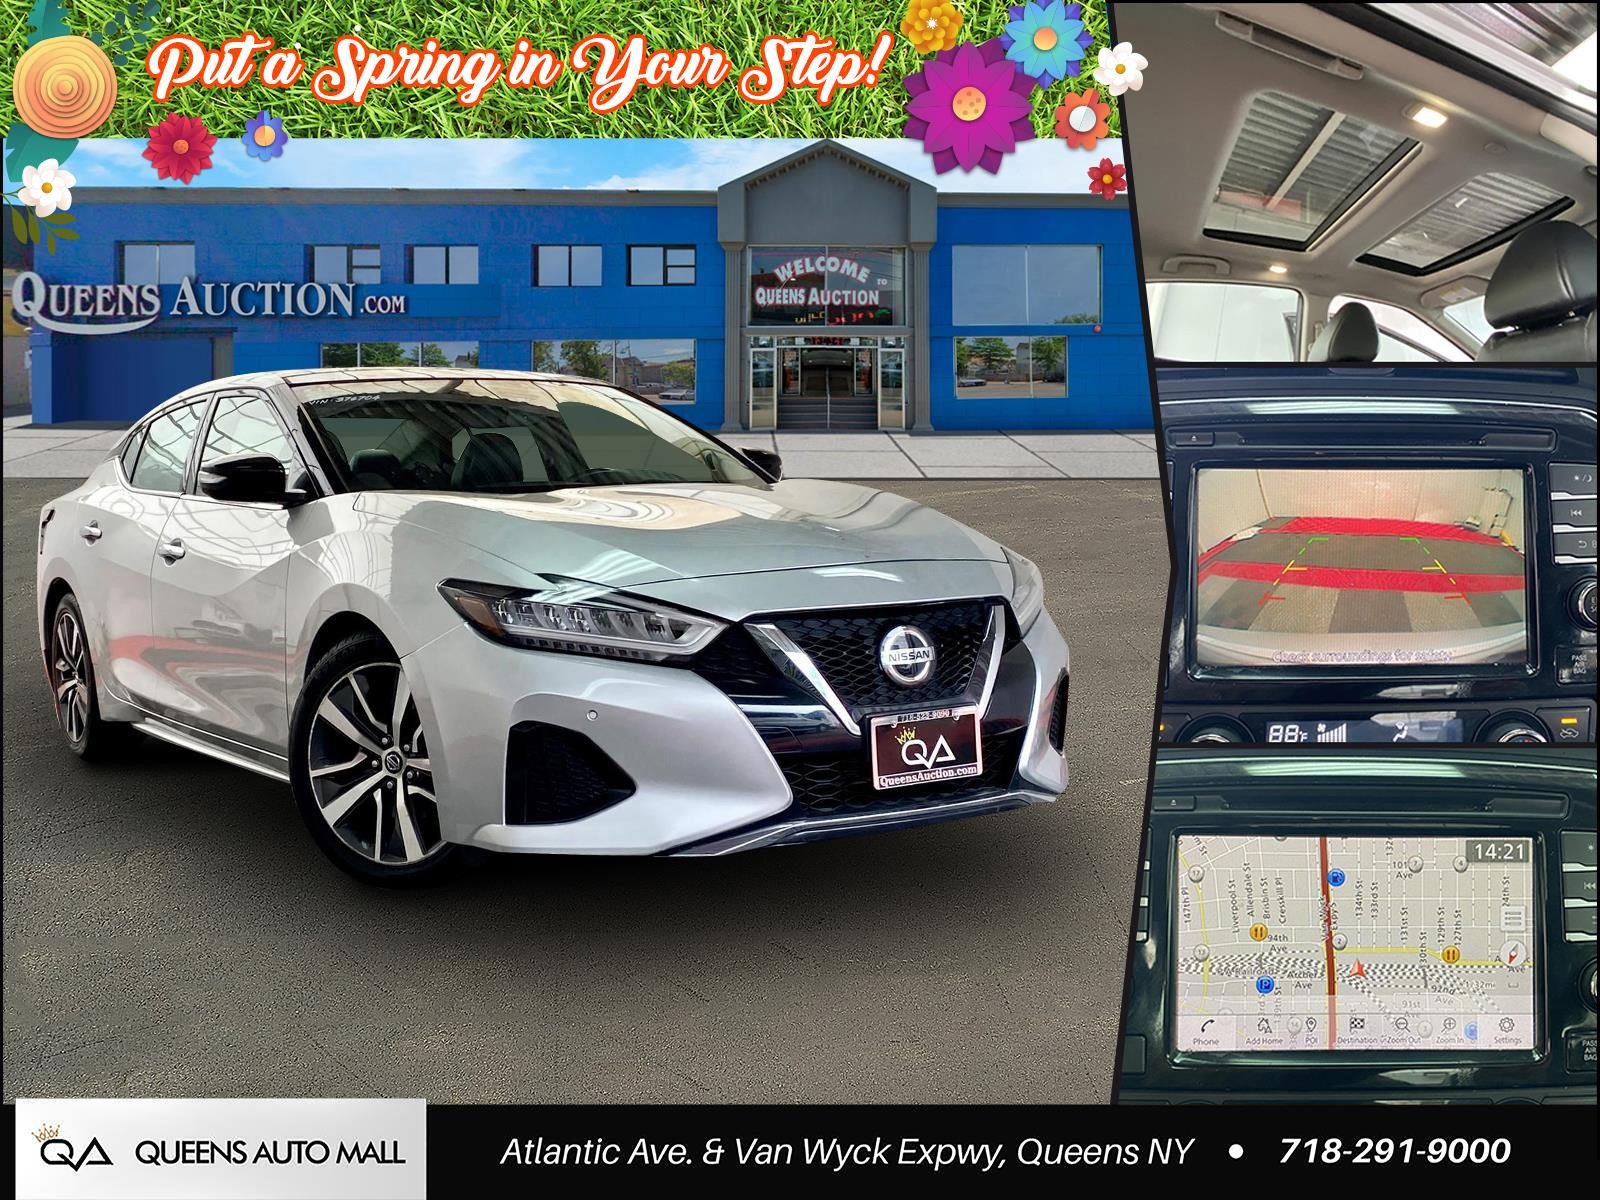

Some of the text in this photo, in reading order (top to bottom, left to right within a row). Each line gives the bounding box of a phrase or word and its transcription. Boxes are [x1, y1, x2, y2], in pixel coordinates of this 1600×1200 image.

[774, 256, 888, 286] WELCOME TO
[755, 287, 879, 306] QUEENS AUCTION
[12, 271, 160, 335] QUEENS
[888, 650, 930, 662] NISSAN
[1272, 650, 1307, 662] Check
[1312, 650, 1392, 663] surroundings
[1393, 650, 1412, 661] for
[902, 735, 956, 769] QA
[879, 765, 977, 788] QueensAuction.com
[1474, 843, 1525, 860] 14:21
[1396, 871, 1413, 879] Ave
[1243, 862, 1255, 917] Allendale St
[1502, 876, 1510, 907] 24th St
[1261, 877, 1271, 920] Brisbin St
[1355, 880, 1363, 917] 134th St
[1371, 882, 1379, 918] 133rd St
[1184, 896, 1192, 924] 147th
[1229, 879, 1240, 934] Liverpool St
[1276, 888, 1287, 924] Cresskill
[1331, 910, 1339, 931] Expy
[1401, 906, 1409, 941] 131st St
[1437, 906, 1445, 943] 129th St
[1267, 934, 1288, 942] 94th
[1419, 931, 1427, 940] St
[1454, 919, 1462, 946] 127th
[1270, 944, 1288, 952] Ave
[1235, 966, 1274, 976] Railroad
[1287, 971, 1318, 979] Archer
[1509, 966, 1526, 974] Ave
[1273, 986, 1282, 996] St
[1295, 982, 1313, 990] Ave
[1431, 984, 1456, 996] 92nd
[1402, 1000, 1421, 1008] 91st
[1436, 996, 1454, 1005] Ave
[1193, 1038, 1220, 1046] Phone
[1305, 1037, 1318, 1045] POI
[1338, 1037, 1378, 1045] Destination
[1387, 1037, 1421, 1045] Zoom Out
[1436, 1037, 1454, 1045] Zoom
[1494, 1037, 1523, 1046] Settings
